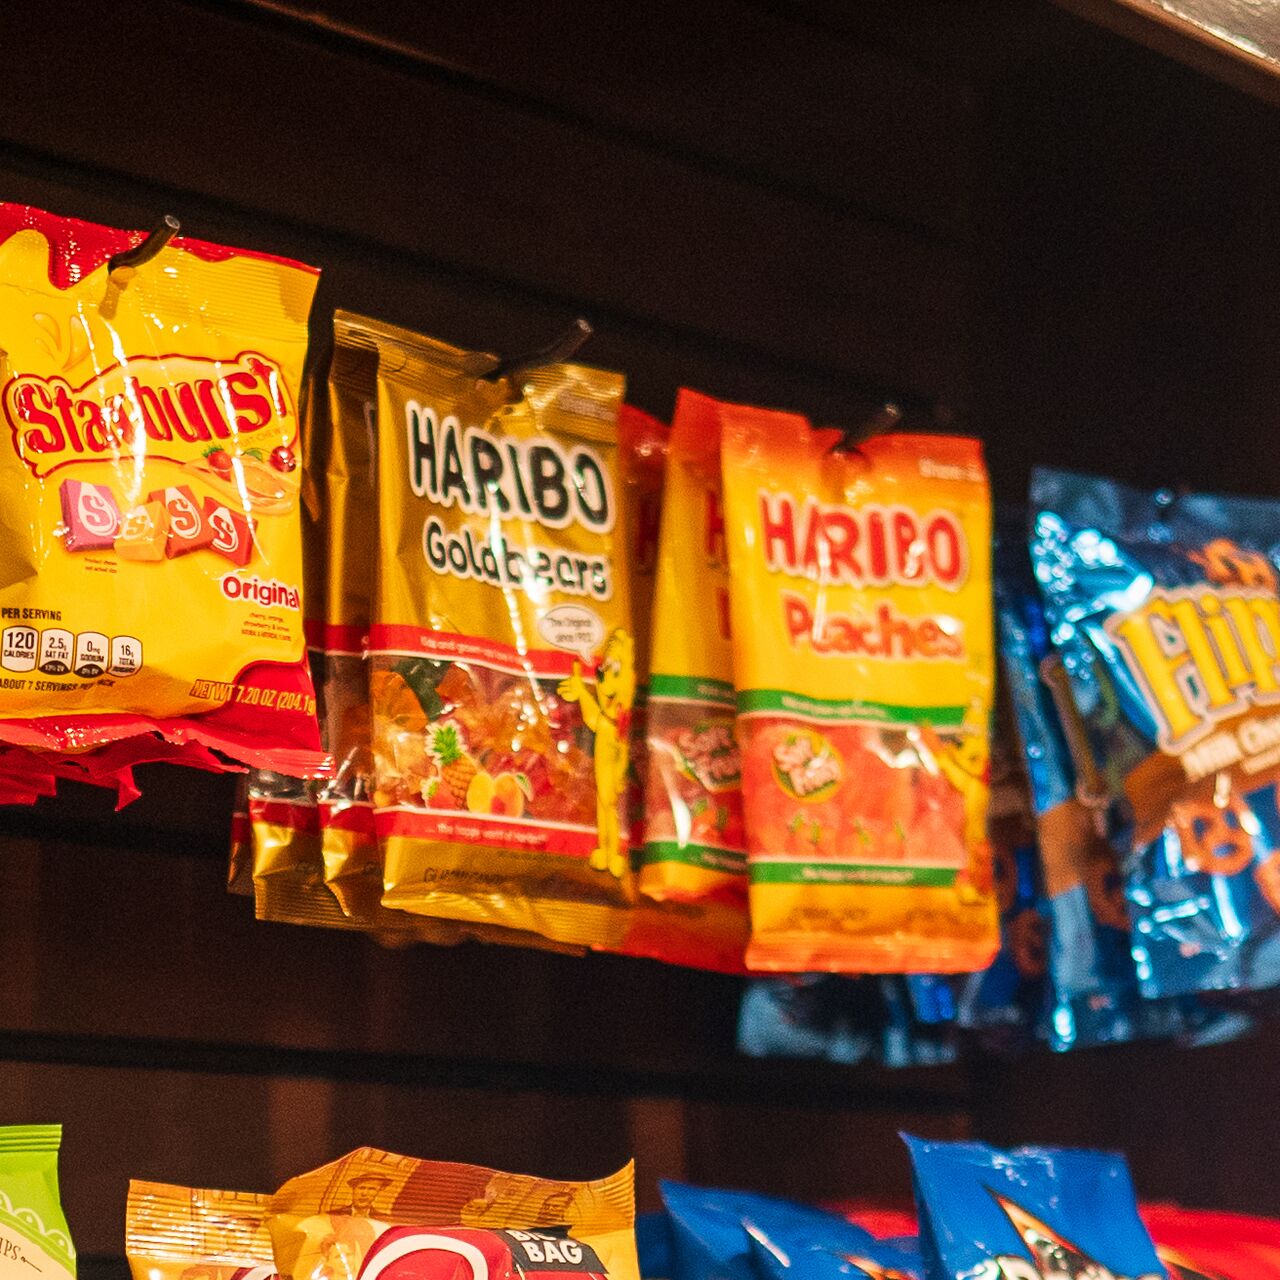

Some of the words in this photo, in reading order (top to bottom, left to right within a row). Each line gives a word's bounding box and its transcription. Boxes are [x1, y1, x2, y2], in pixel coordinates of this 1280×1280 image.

[15, 357, 287, 454] Starburst
[408, 404, 612, 531] HARIBO
[759, 491, 964, 587] HARIBO
[222, 575, 300, 609] Original
[1, 607, 20, 619] PER
[22, 608, 62, 621] SERVING
[7, 632, 35, 649] 120
[190, 679, 214, 700] NET
[235, 685, 262, 705] 7.20
[261, 688, 277, 707] OZ
[521, 1240, 583, 1265] BAG
